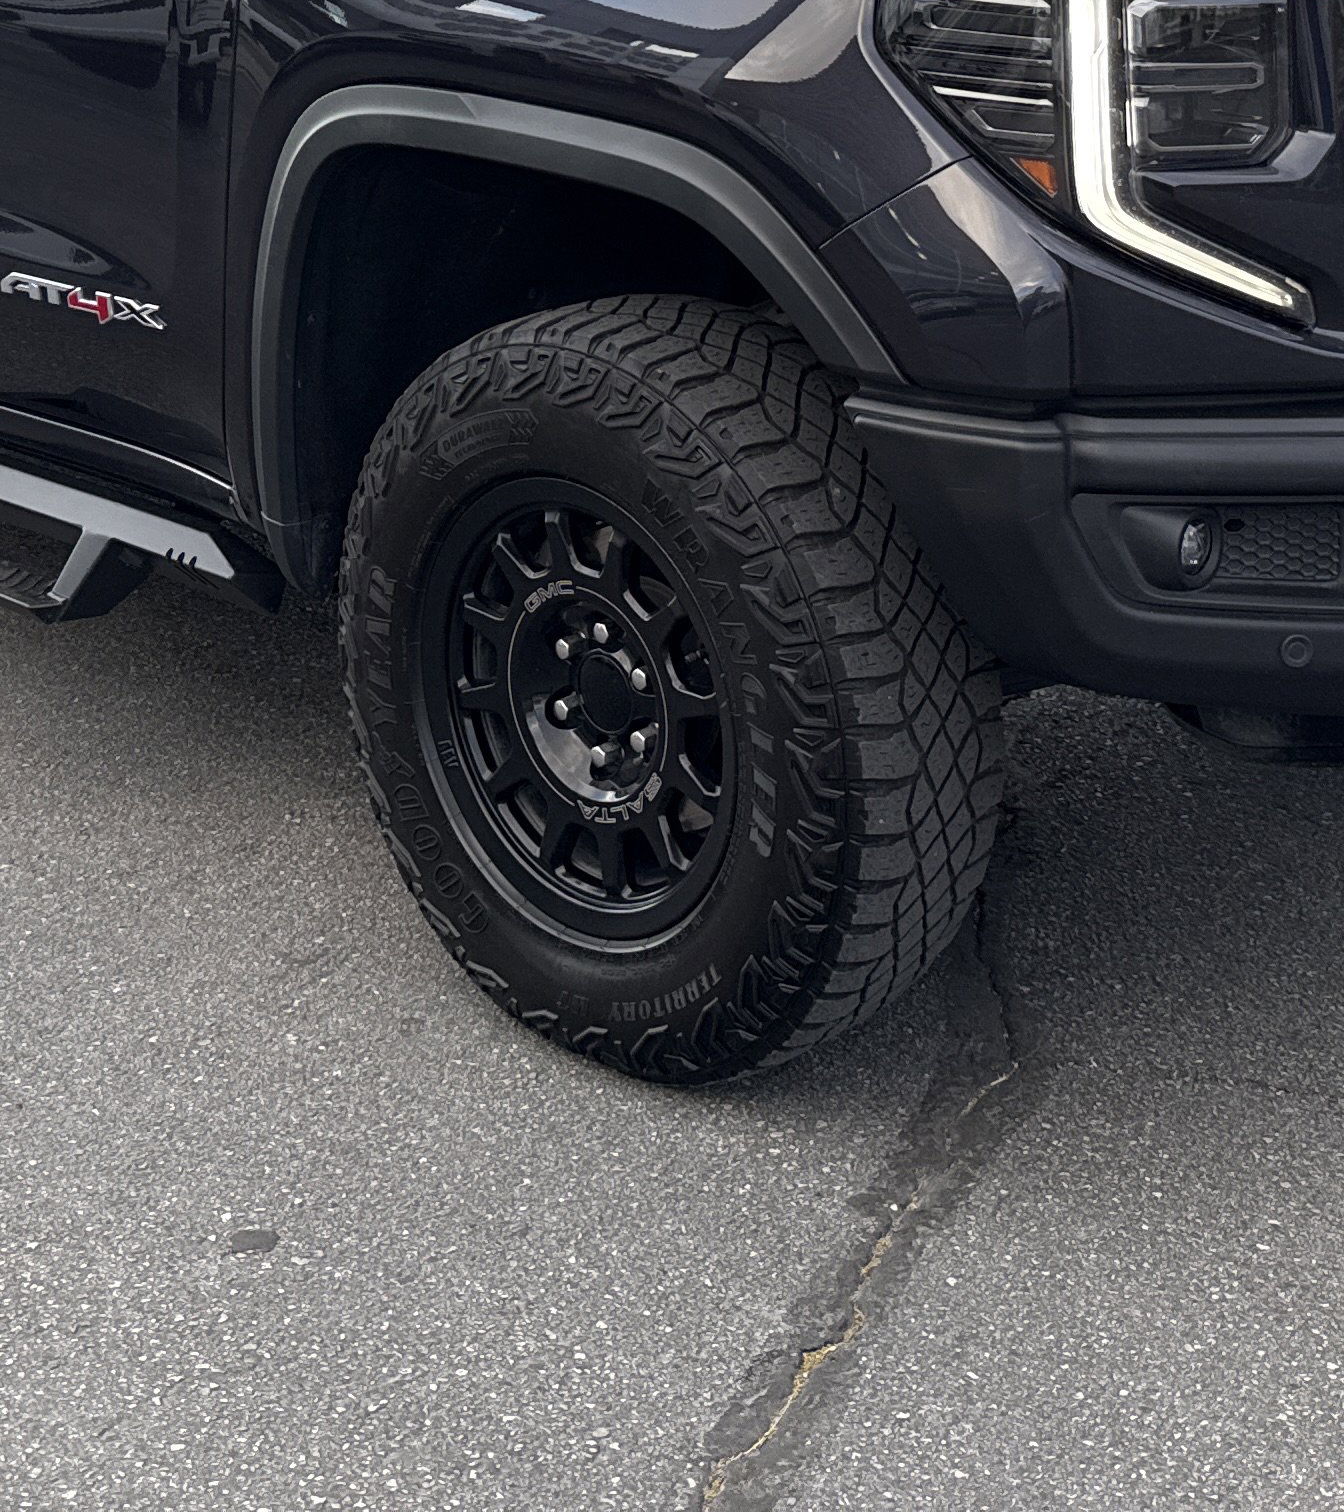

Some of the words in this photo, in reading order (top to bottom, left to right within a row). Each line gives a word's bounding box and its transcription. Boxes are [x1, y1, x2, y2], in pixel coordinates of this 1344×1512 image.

[0, 271, 167, 330] AT4X
[523, 580, 575, 614] GMC
[641, 477, 777, 860] WRANGLER
[362, 566, 489, 934] GOODYEAR
[609, 962, 723, 1022] TERRITORY
